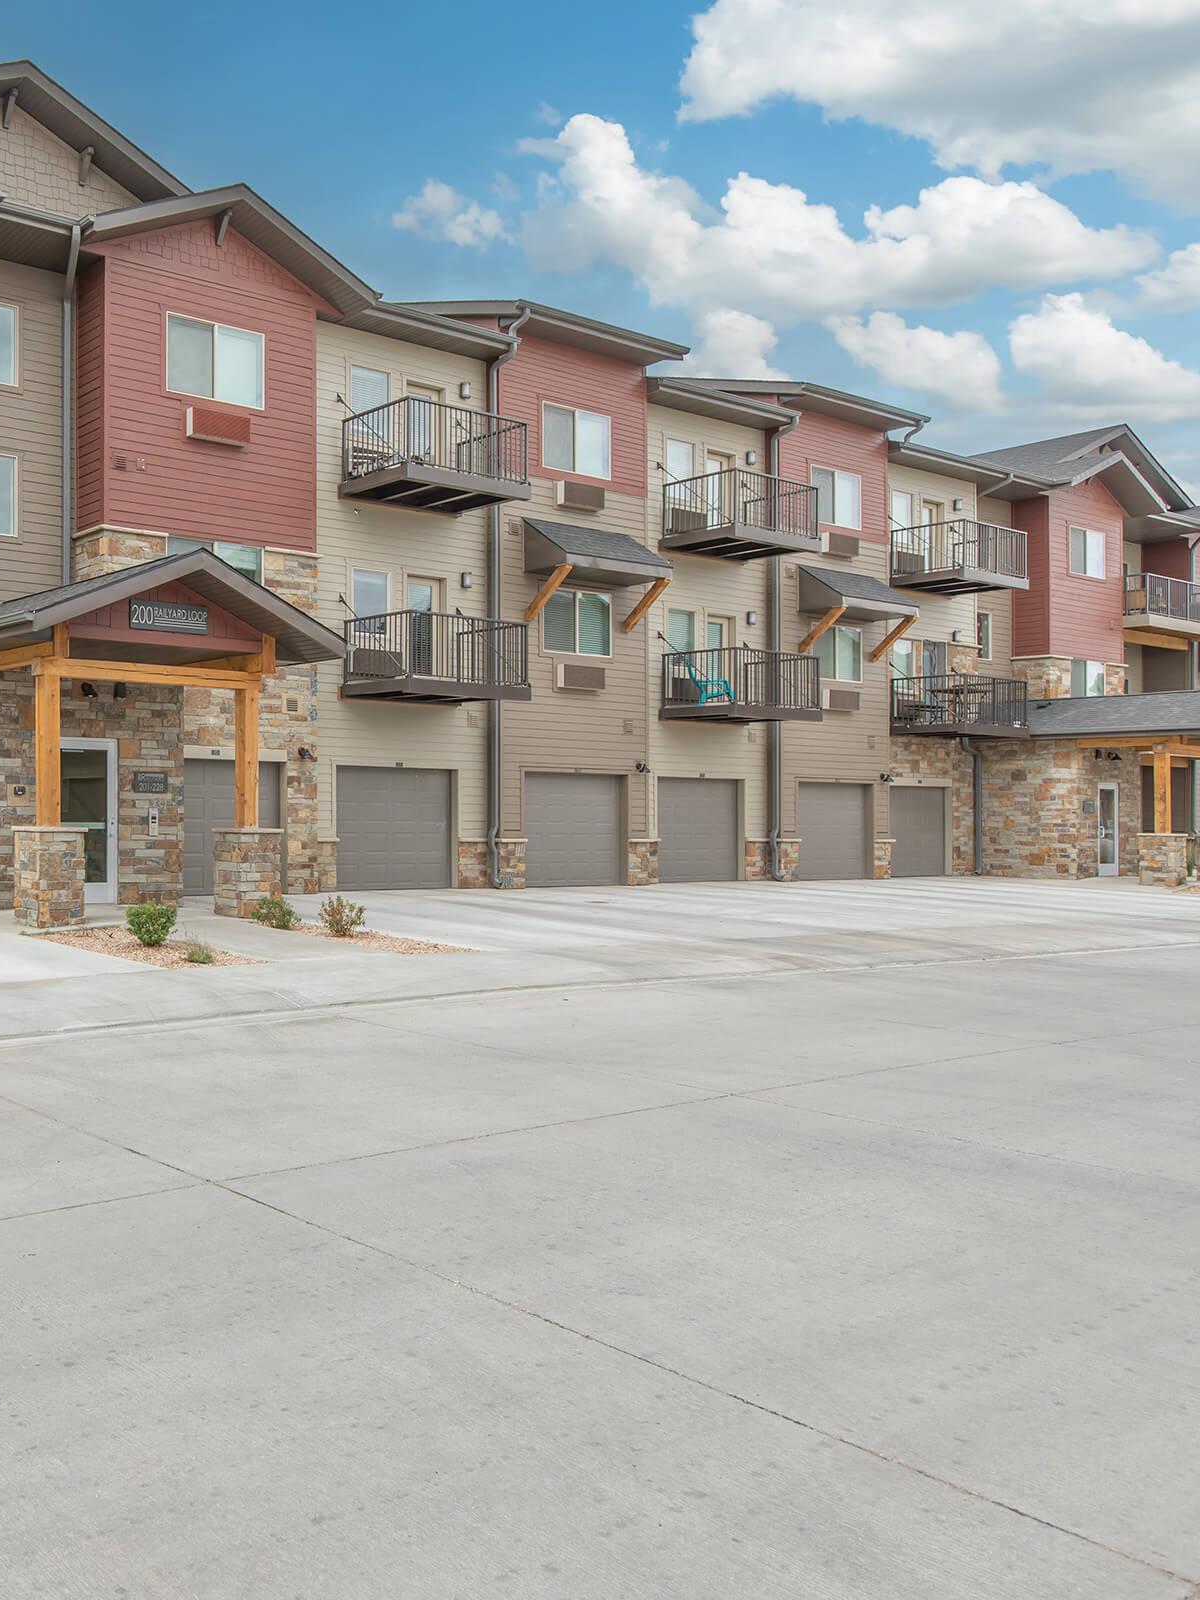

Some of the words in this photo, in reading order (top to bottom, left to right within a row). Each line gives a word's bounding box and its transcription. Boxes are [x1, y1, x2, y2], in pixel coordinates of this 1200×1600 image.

[132, 604, 153, 625] 200
[153, 607, 186, 620] RAILYARD
[187, 610, 207, 622] LOOP
